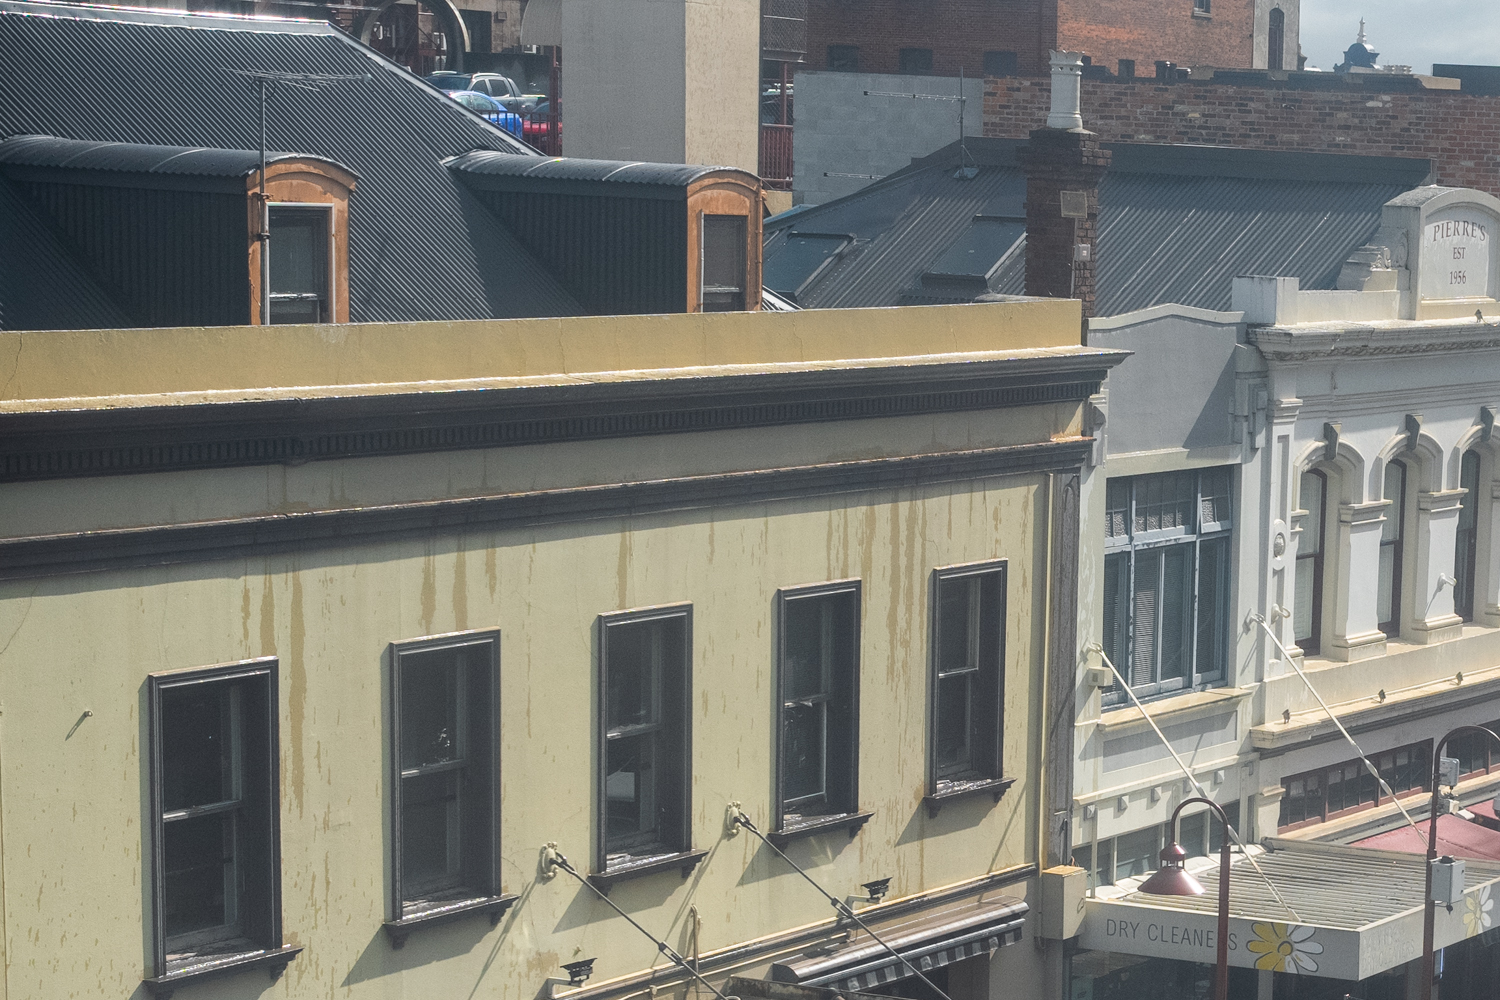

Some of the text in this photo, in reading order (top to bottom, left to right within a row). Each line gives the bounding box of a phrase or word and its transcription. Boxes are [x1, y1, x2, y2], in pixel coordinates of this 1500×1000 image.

[1433, 220, 1486, 242] PIERRE'S
[1452, 246, 1466, 260] EST
[1449, 270, 1467, 285] 1956
[1106, 918, 1237, 951] DRY CLEANES
